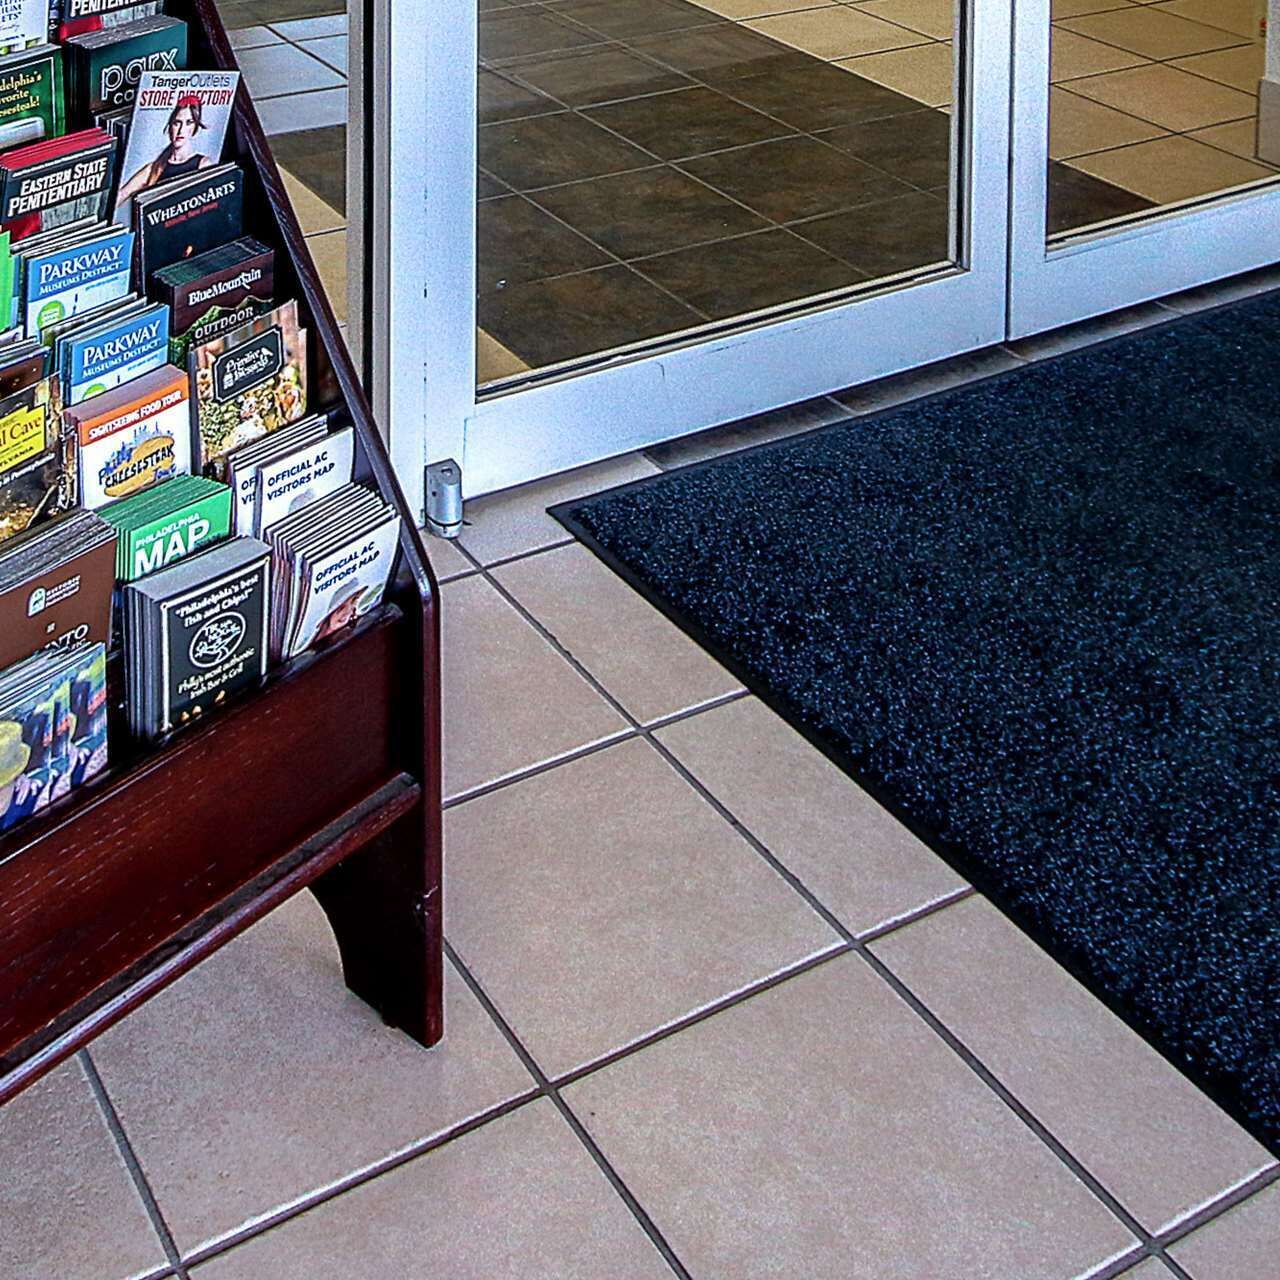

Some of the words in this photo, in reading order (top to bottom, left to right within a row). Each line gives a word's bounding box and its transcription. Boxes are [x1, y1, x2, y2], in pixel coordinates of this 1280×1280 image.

[101, 48, 179, 100] parx
[8, 173, 106, 217] PENITENTIARY
[21, 172, 72, 197] EASTERN
[75, 157, 107, 180] STATE
[39, 244, 124, 284] PARKWAY
[194, 305, 255, 340] OUTDOOR
[82, 320, 161, 367] PARKWAY
[10, 417, 40, 439] Cave
[266, 458, 312, 487] OFFICIAL
[314, 450, 329, 465] AC
[266, 473, 312, 501] VISITORS
[313, 461, 336, 479] MAP
[314, 565, 358, 595] VISITORS
[359, 550, 380, 569] MAP
[315, 552, 358, 582] OFFICIAL
[360, 541, 375, 557] AC
